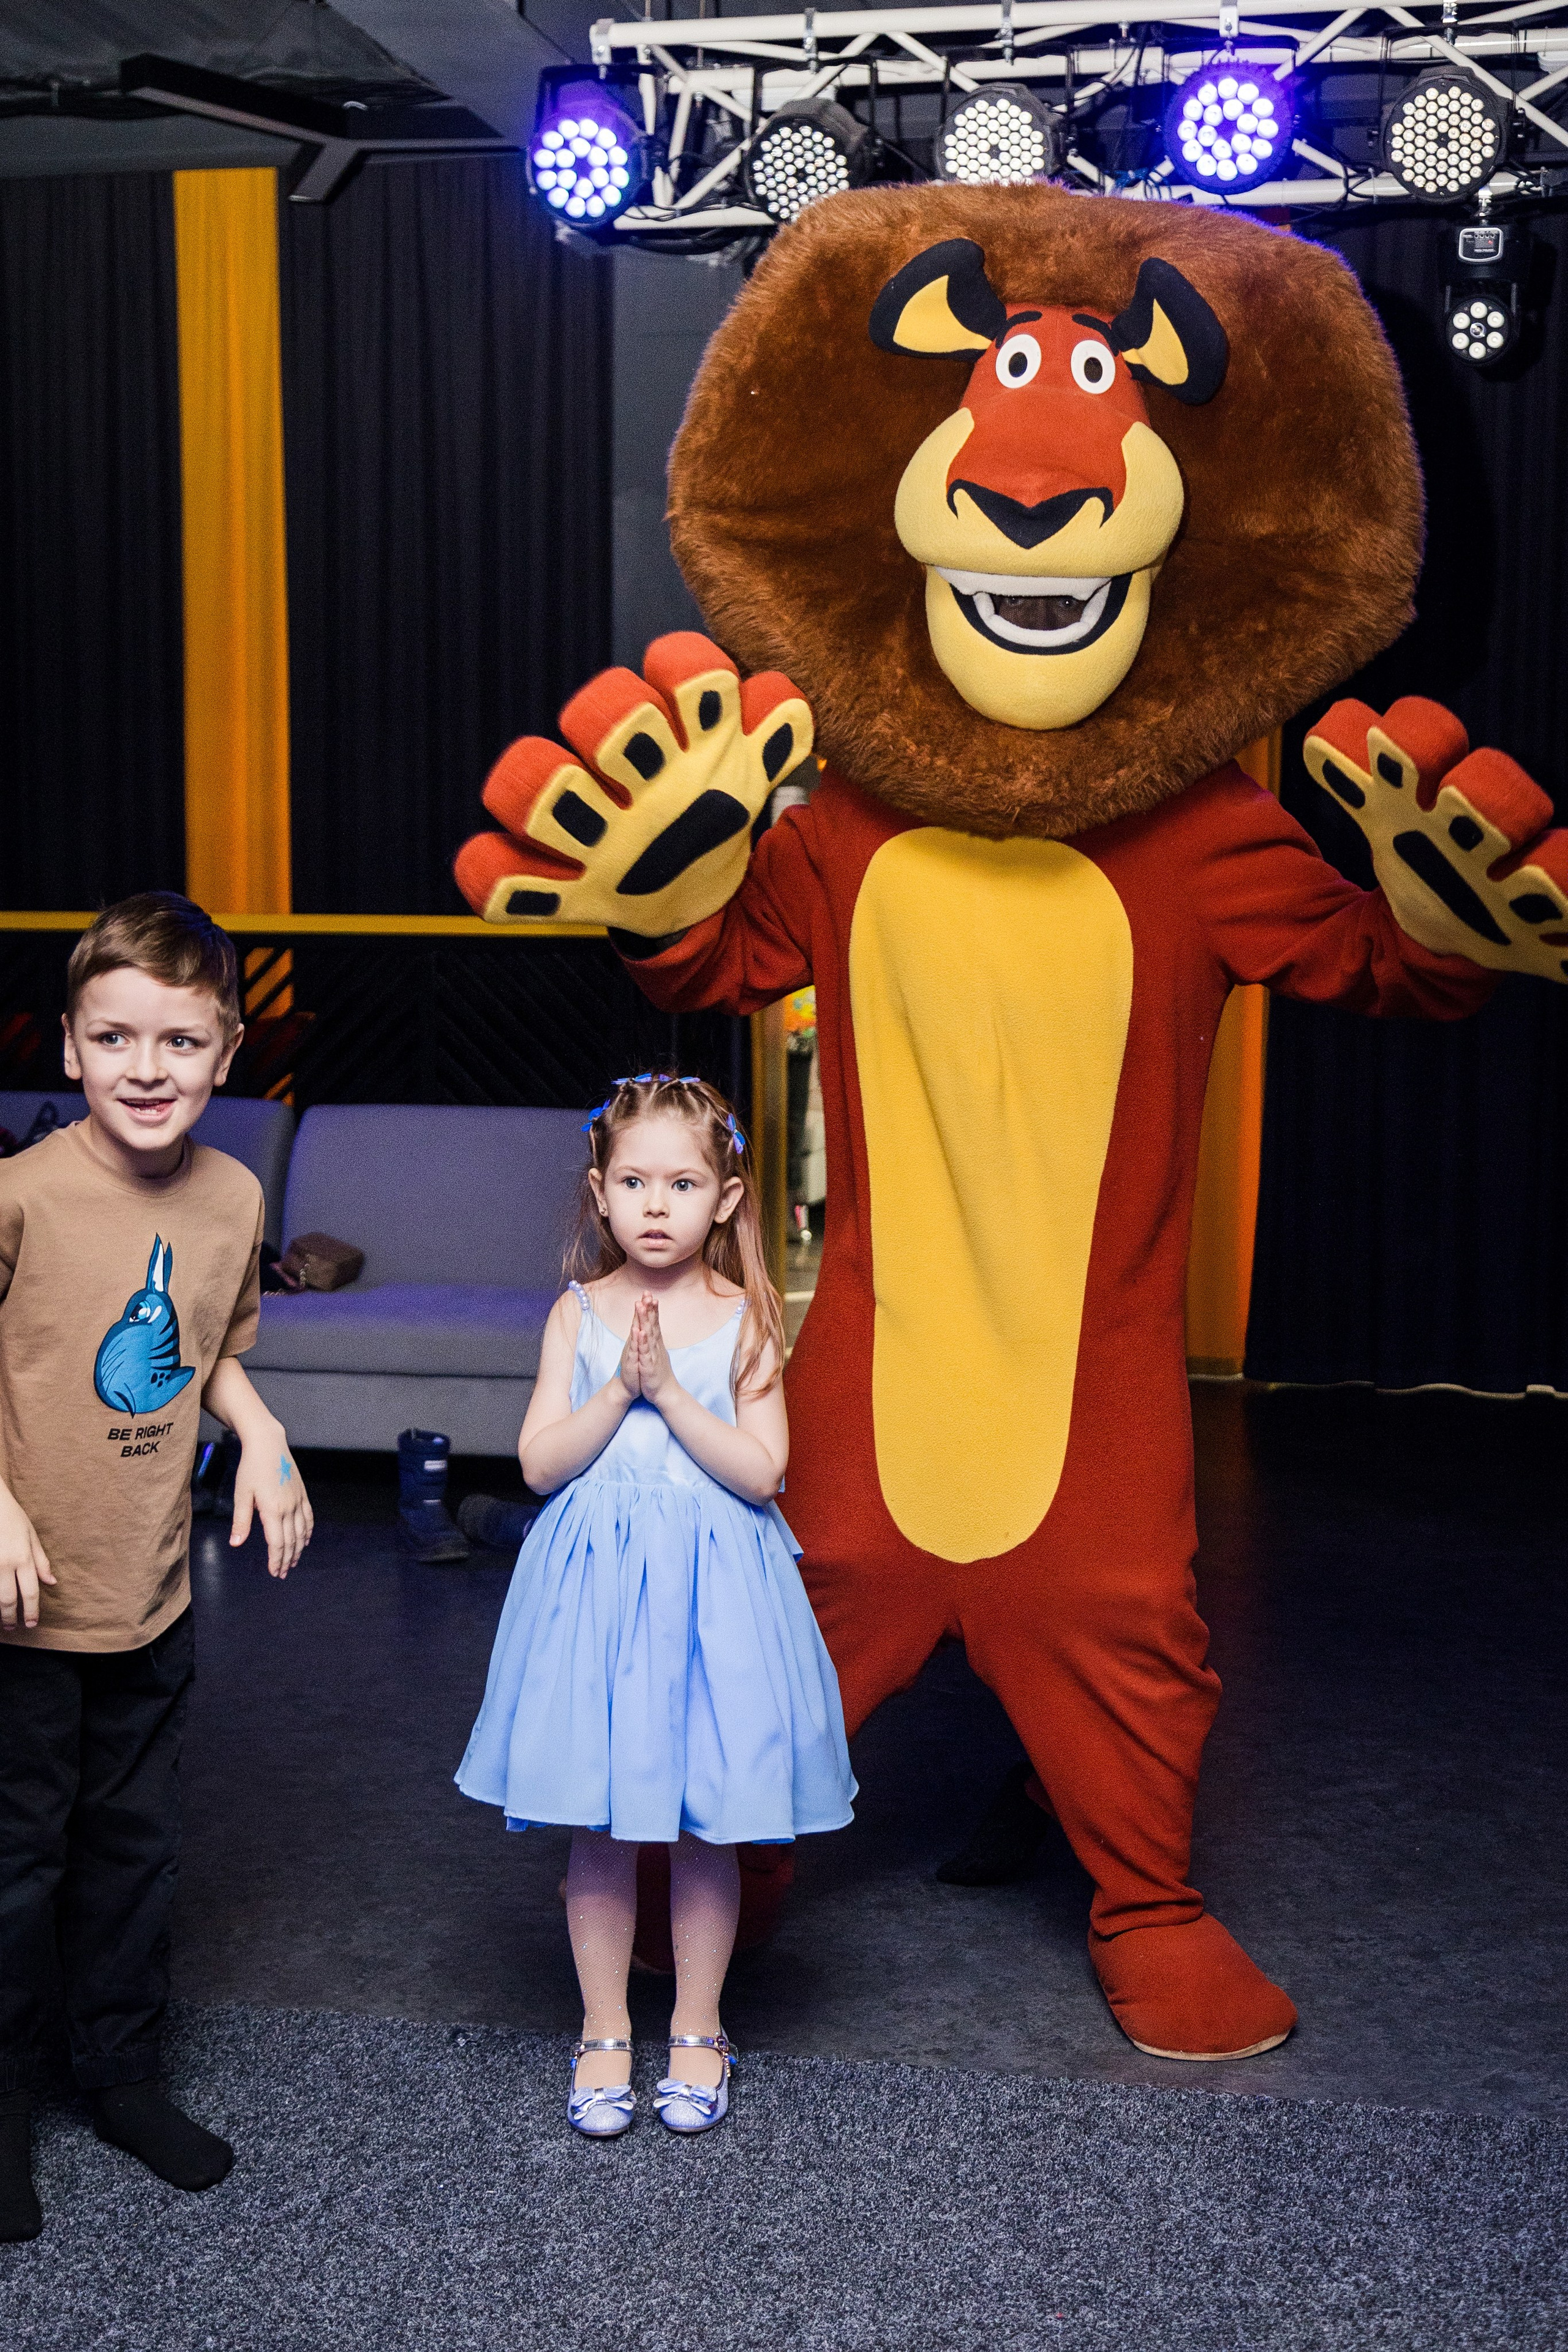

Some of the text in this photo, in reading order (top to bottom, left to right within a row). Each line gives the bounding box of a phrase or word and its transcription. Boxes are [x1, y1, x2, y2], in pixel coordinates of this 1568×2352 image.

[107, 1422, 174, 1441] BE RIGHT
[120, 1441, 160, 1457] BACK
